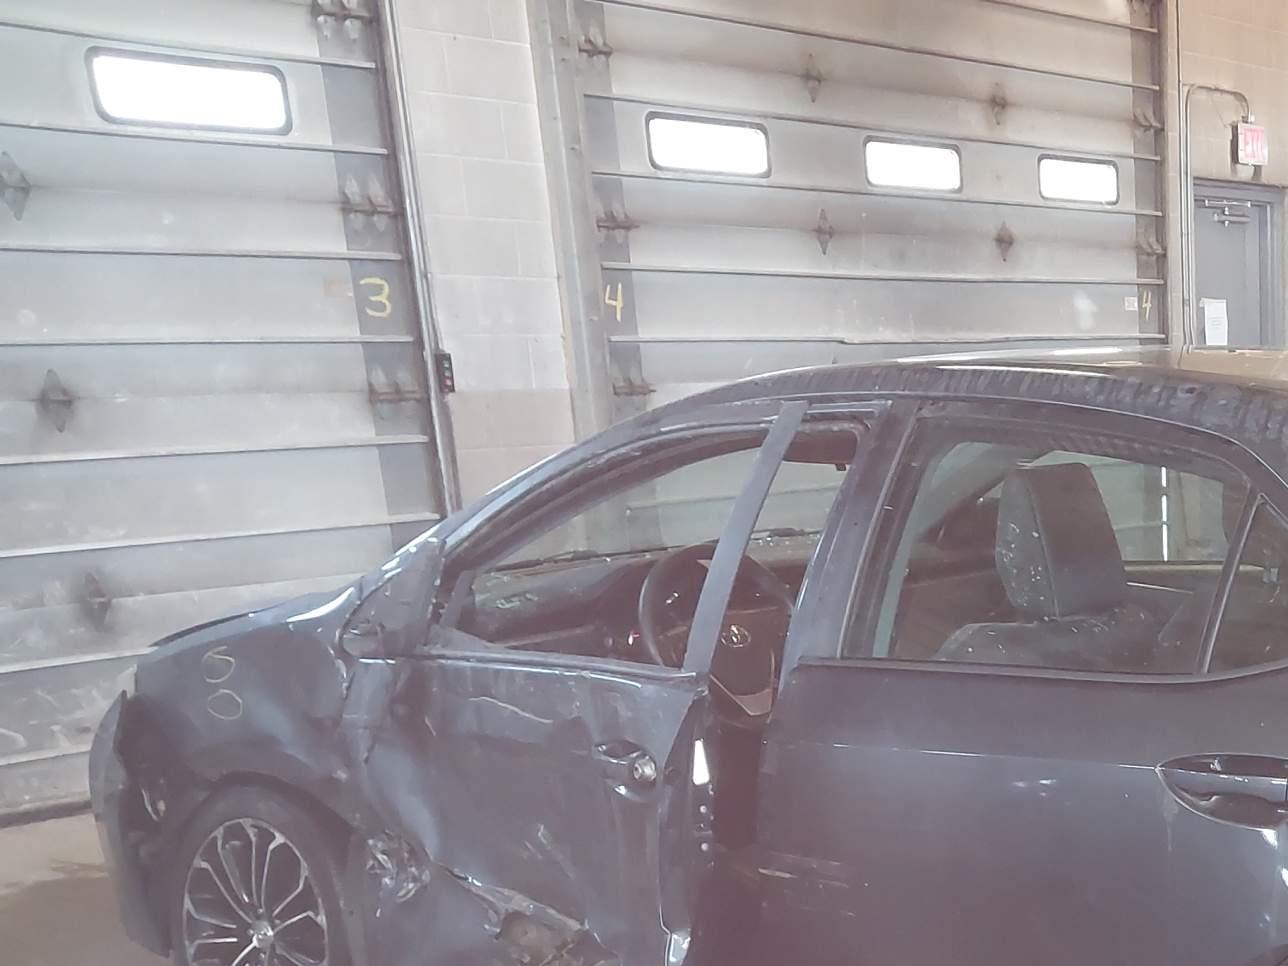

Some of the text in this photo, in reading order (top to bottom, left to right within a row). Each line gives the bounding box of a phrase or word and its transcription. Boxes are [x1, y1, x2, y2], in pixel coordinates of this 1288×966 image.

[359, 277, 391, 317] 3
[604, 282, 623, 322] 4
[1142, 290, 1152, 321] 4
